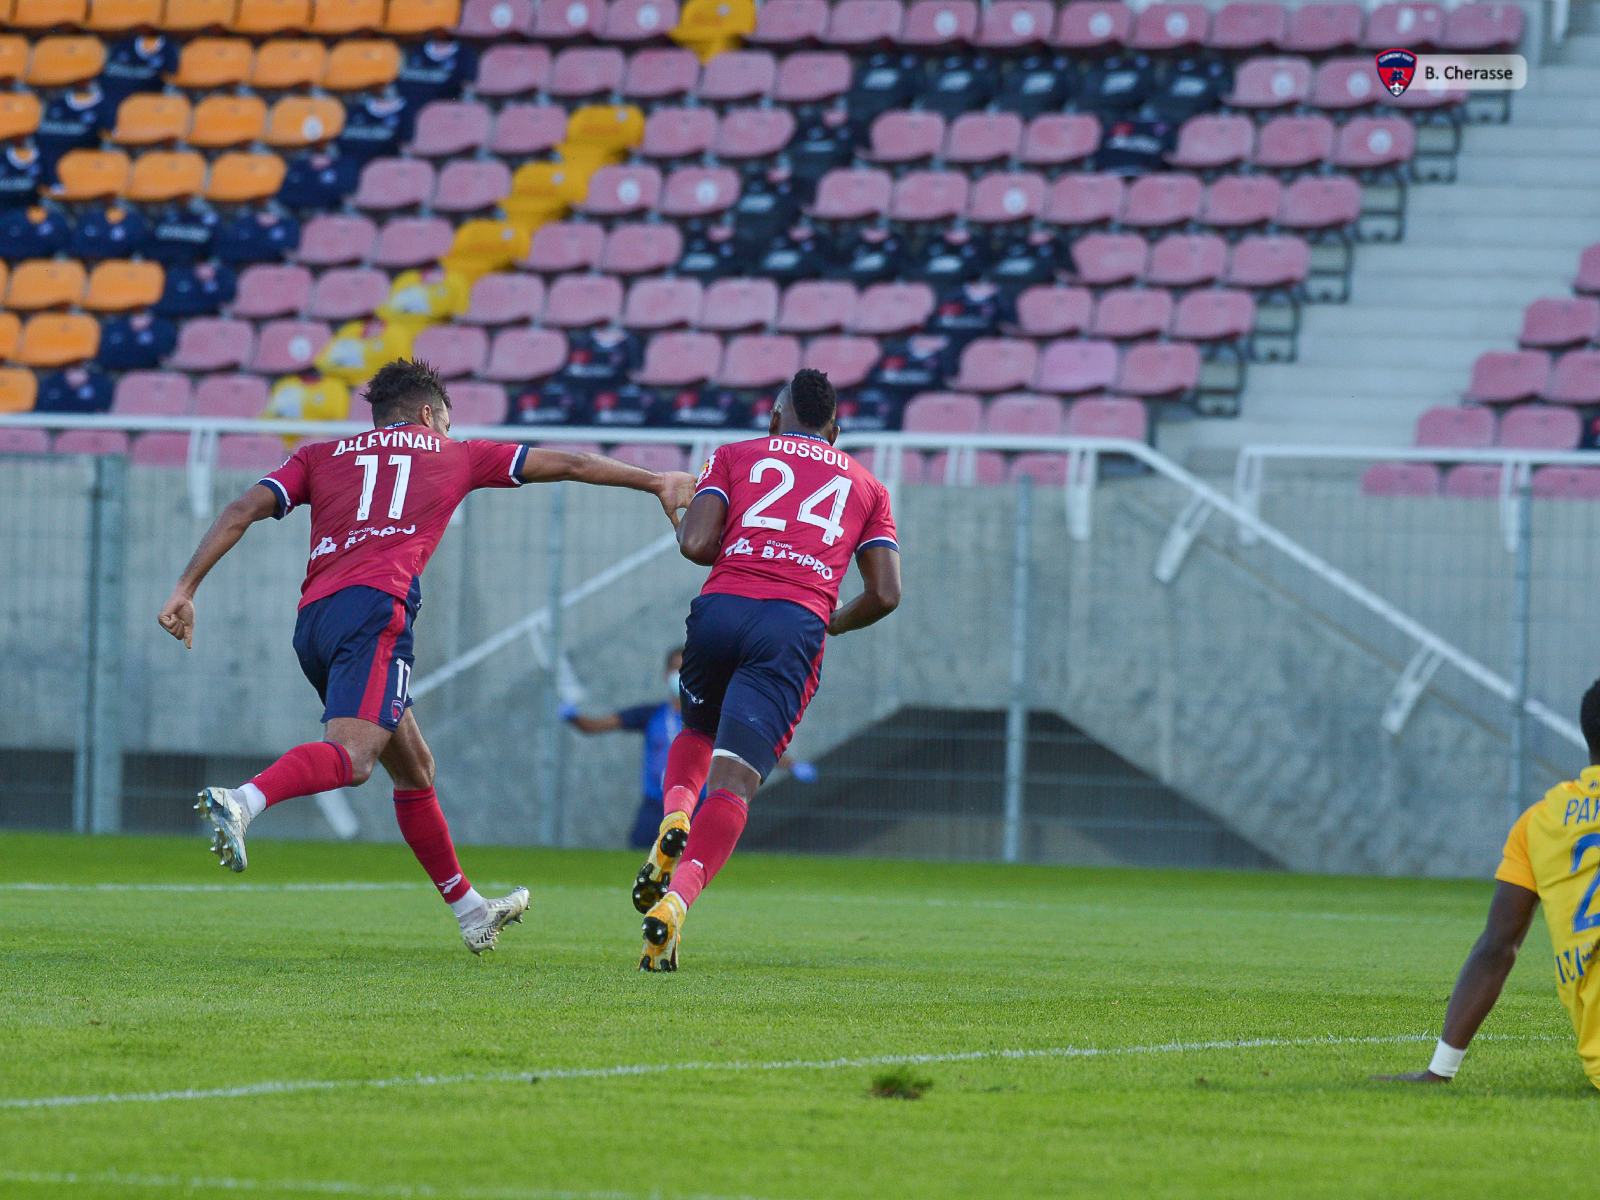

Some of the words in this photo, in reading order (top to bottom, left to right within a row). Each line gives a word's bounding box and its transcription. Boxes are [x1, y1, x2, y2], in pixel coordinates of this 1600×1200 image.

[332, 431, 441, 457] ALLEVINAH
[768, 438, 849, 471] DOSSOU
[354, 454, 412, 522] 11
[741, 457, 853, 546] 24
[766, 539, 793, 550] GROUPE
[760, 545, 833, 580] BATIPRO
[395, 657, 411, 703] 11
